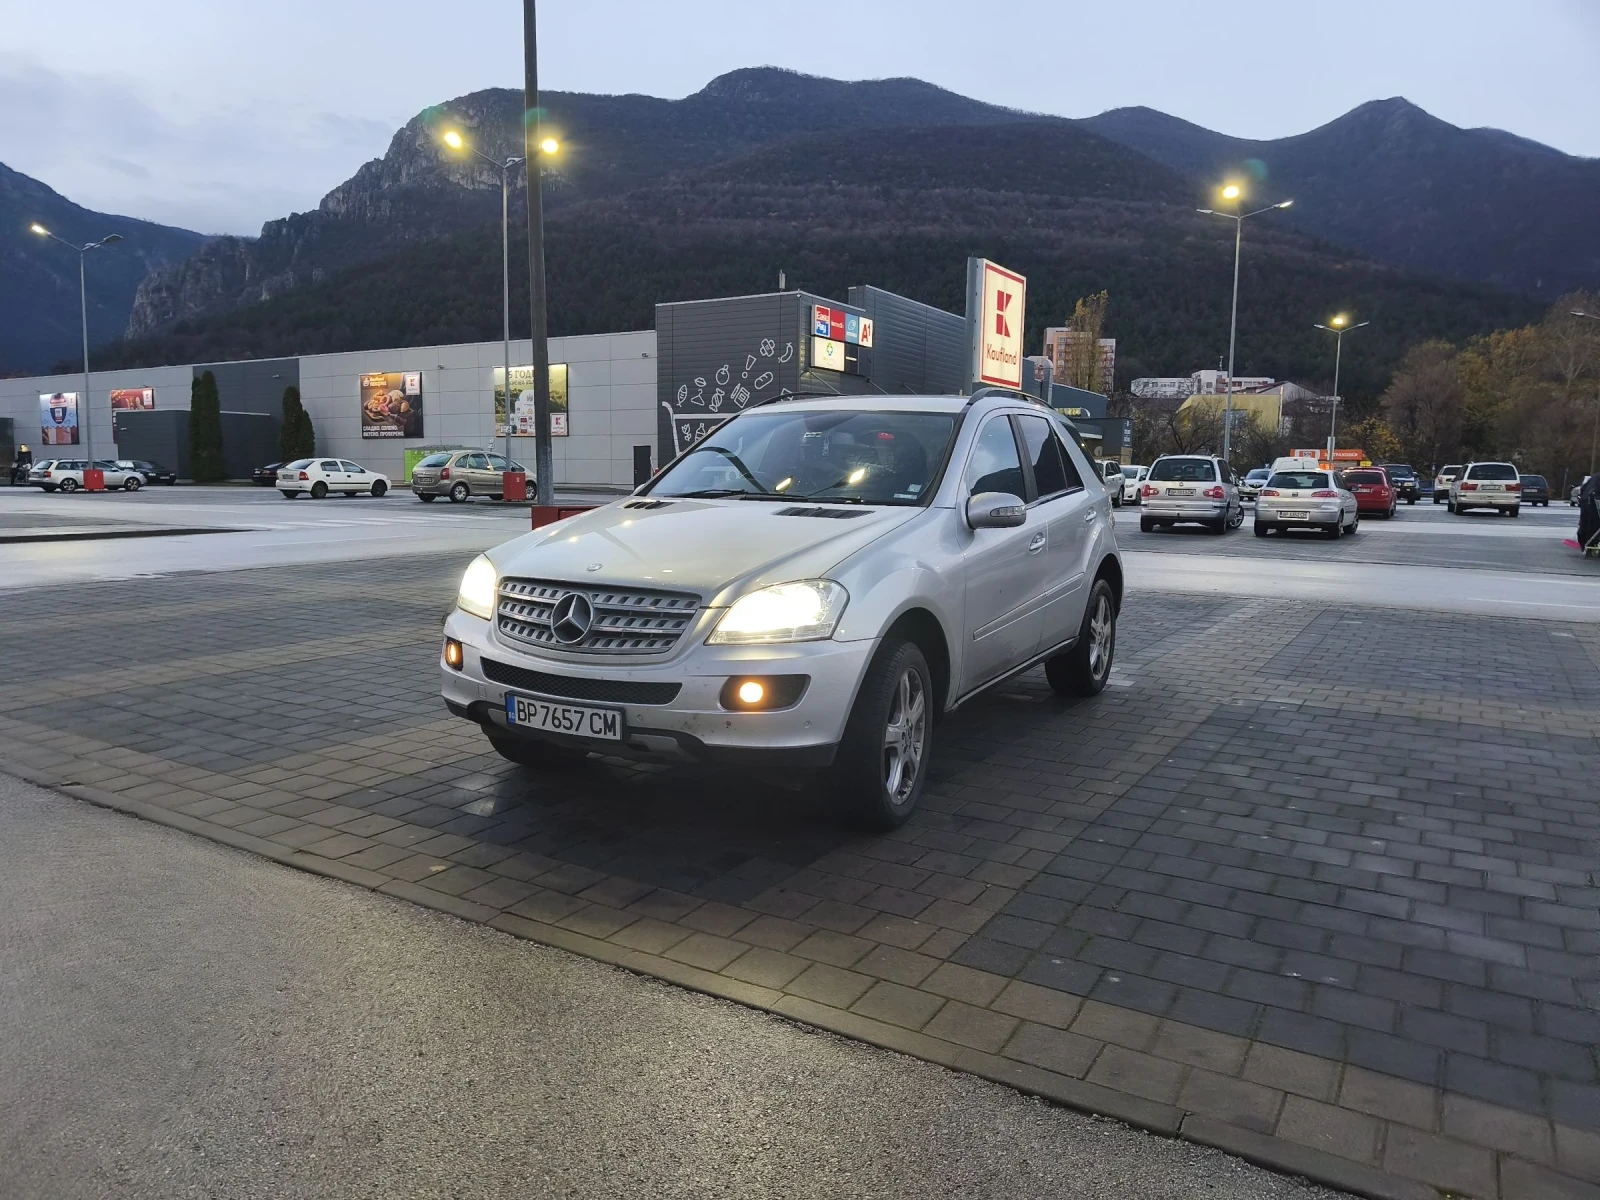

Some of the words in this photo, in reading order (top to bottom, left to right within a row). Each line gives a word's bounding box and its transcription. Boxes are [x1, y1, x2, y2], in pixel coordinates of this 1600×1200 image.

[816, 310, 829, 321] Easy
[816, 321, 827, 333] Pay
[861, 322, 871, 342] A1
[986, 343, 1018, 365] Kaufland
[517, 700, 537, 723] BP
[540, 704, 585, 732] 7657
[589, 712, 617, 736] CM
